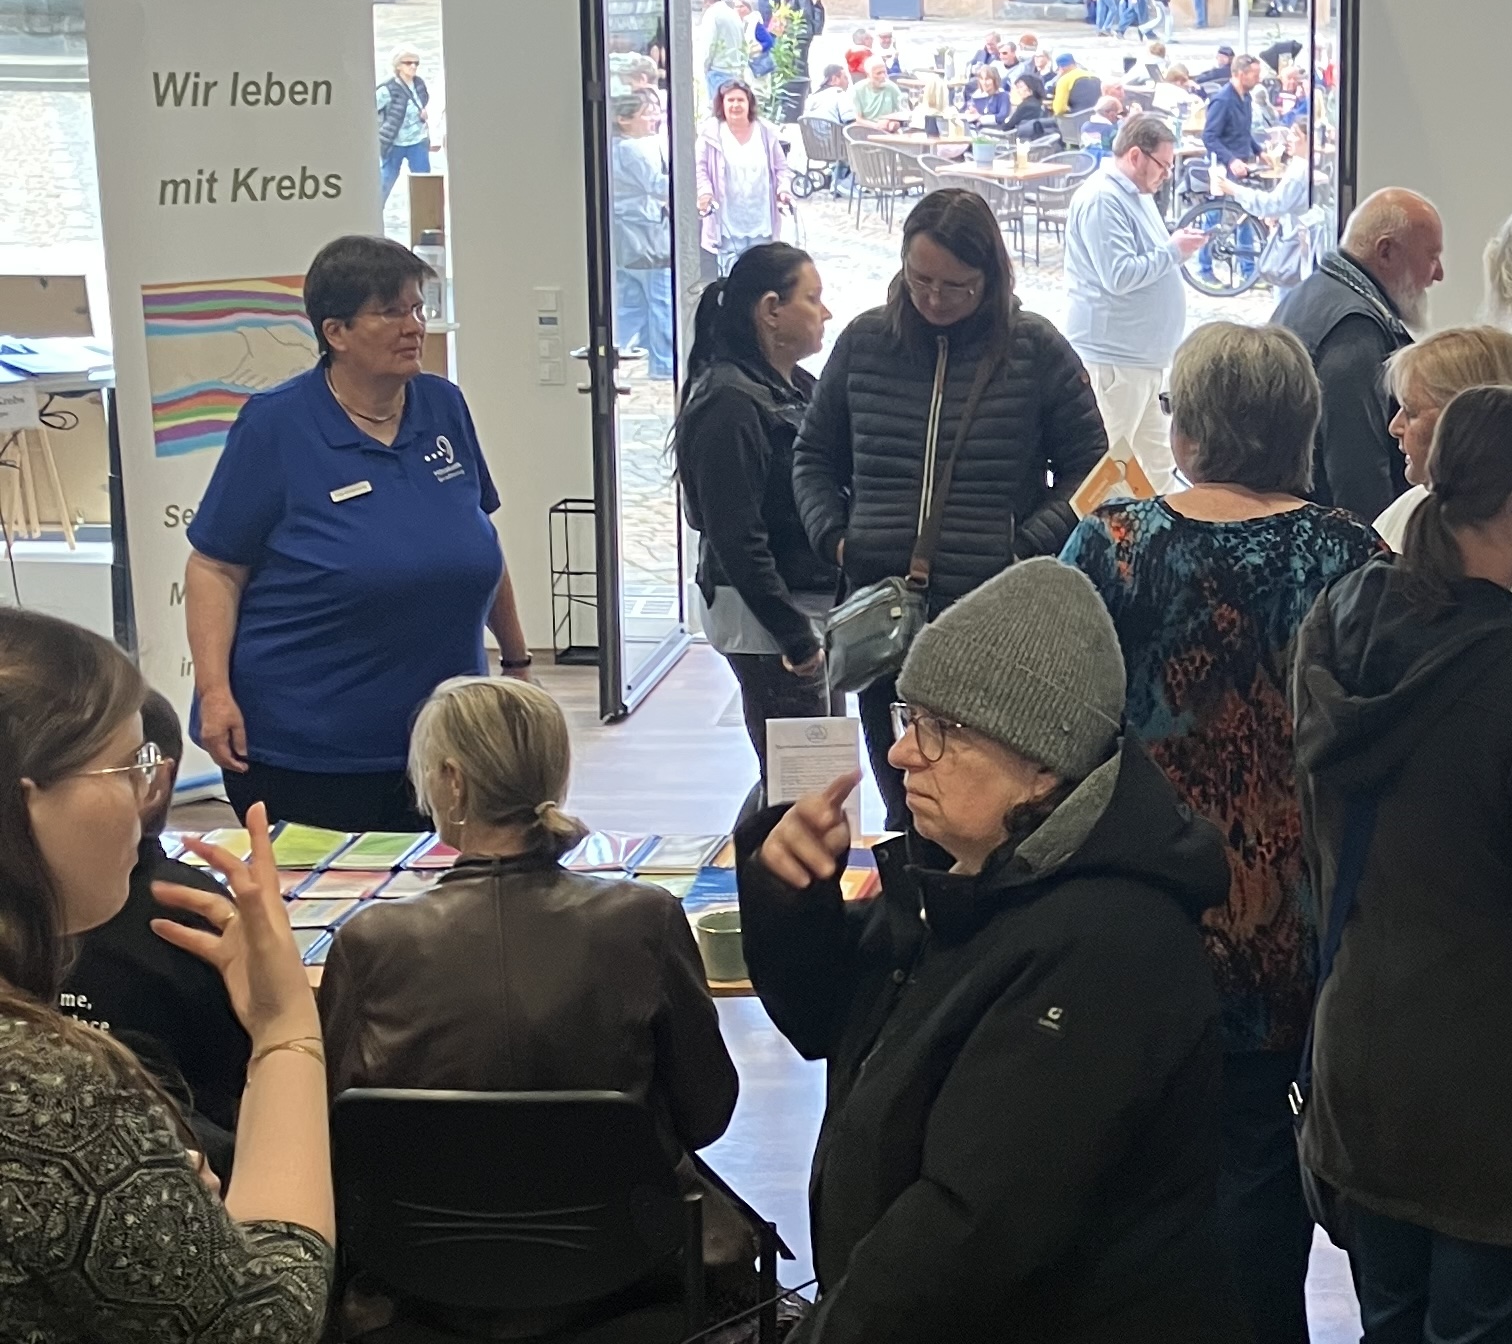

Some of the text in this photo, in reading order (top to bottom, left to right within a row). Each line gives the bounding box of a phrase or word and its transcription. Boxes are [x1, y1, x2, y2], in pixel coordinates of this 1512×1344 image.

[152, 71, 333, 107] Wir leben
[158, 165, 343, 206] mit Krebs
